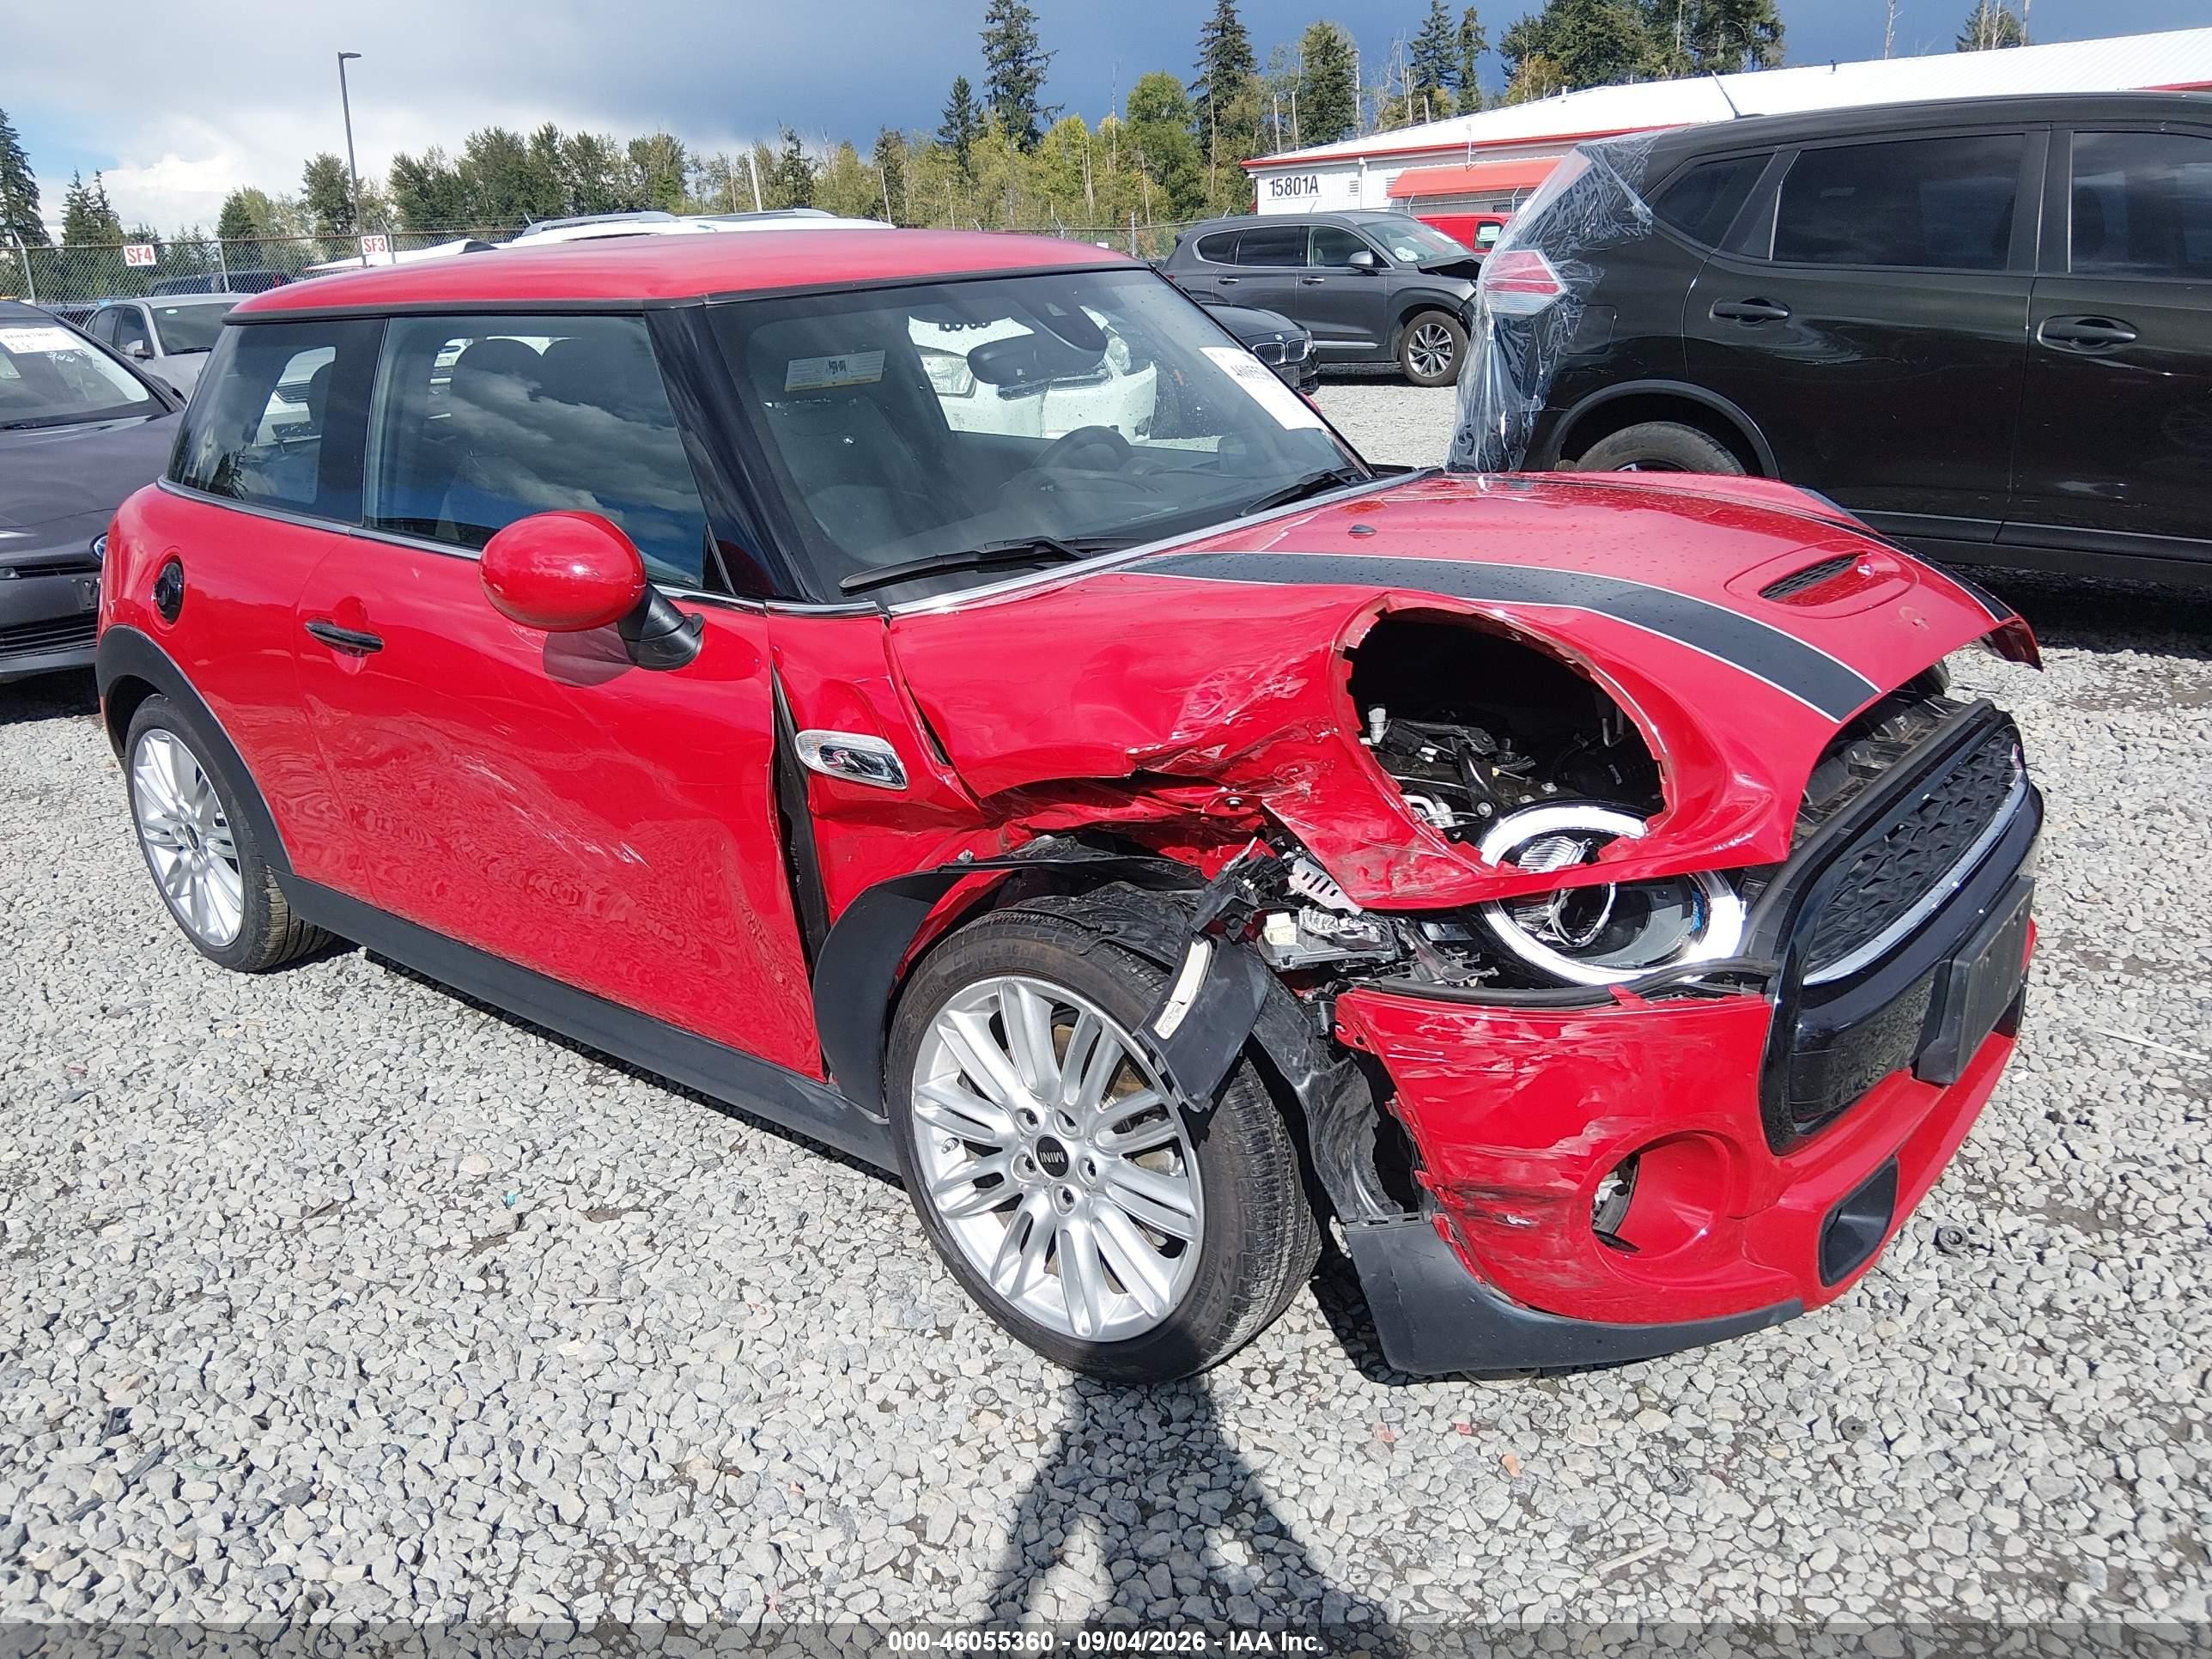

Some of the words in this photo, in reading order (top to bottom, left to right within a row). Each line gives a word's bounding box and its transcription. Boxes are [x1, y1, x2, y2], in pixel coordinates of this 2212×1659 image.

[1269, 174, 1320, 198] 15801A
[363, 237, 386, 252] SF3
[126, 246, 154, 264] SF4
[1039, 1152, 1066, 1164] MINI
